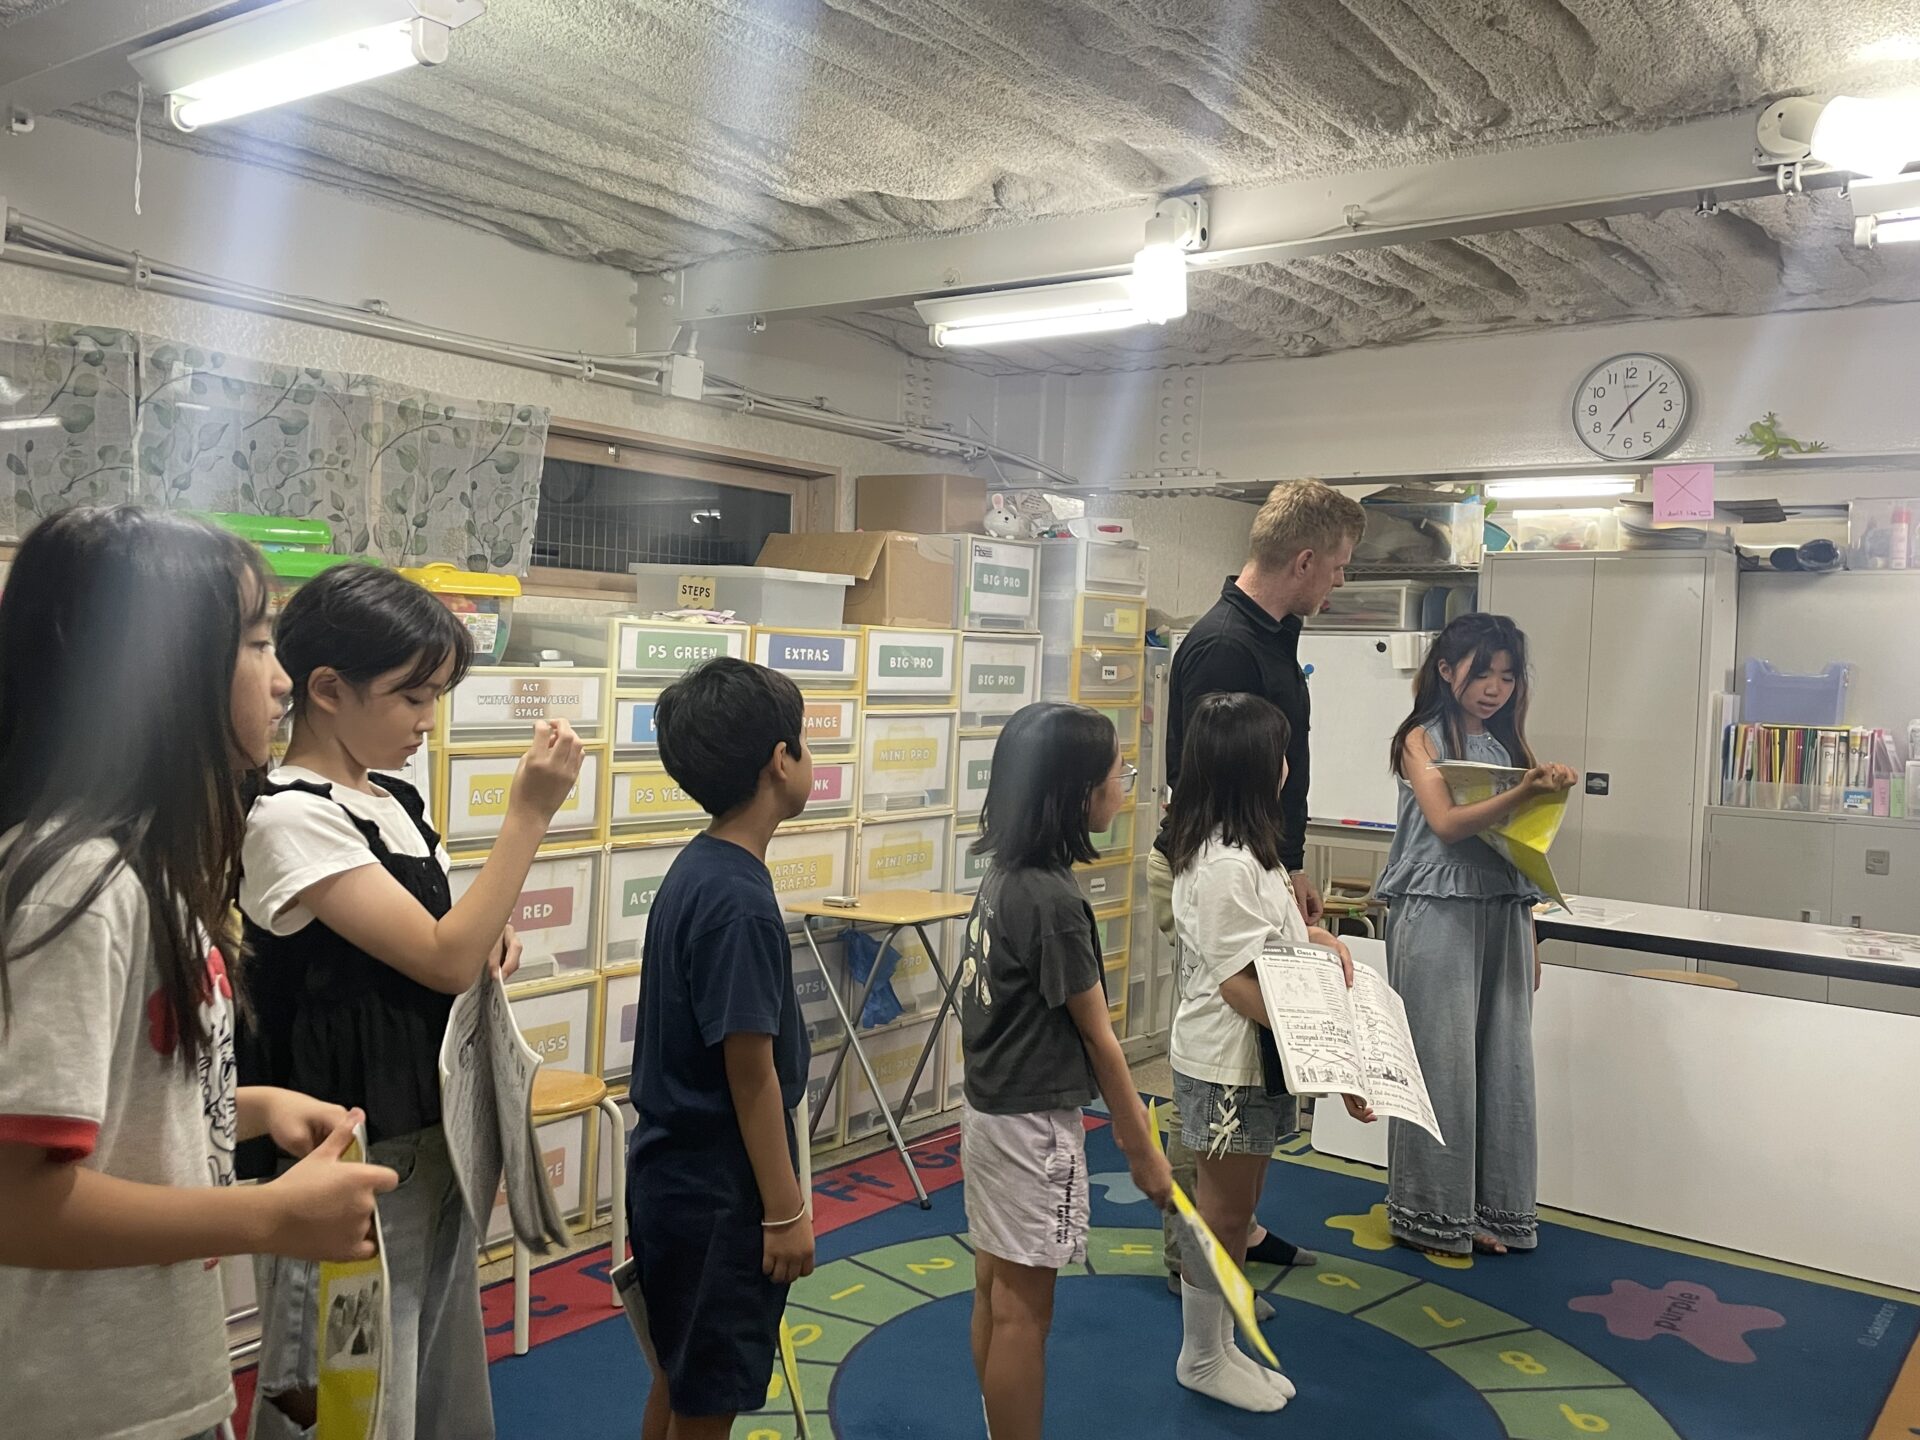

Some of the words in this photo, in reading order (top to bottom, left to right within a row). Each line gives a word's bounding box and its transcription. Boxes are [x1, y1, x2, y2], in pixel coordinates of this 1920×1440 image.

[1608, 373, 1618, 385] 11
[1625, 366, 1638, 379] 12
[1648, 370, 1652, 382] 1
[1593, 386, 1606, 399] 10
[1658, 382, 1668, 394] 2
[1588, 404, 1598, 417] 9
[1663, 399, 1673, 412] 3
[1592, 421, 1602, 434] 8
[1656, 417, 1666, 430] 4
[1606, 433, 1616, 446] 7
[1623, 437, 1633, 449] 6
[1642, 431, 1652, 443] 5
[983, 573, 1000, 586] BIG
[1003, 576, 1021, 588] PRO
[681, 584, 711, 598] STEPS
[648, 644, 668, 659] PS
[673, 646, 718, 660] GREEN
[784, 647, 830, 662] EXTRAS
[889, 655, 909, 668] BIG
[913, 656, 934, 669] PRO
[522, 683, 540, 692] ACT
[977, 674, 995, 686] BIG
[998, 674, 1016, 687] PRO
[477, 694, 579, 705] WHITE/BROWN/BEIGE
[515, 707, 545, 718] STAGE
[802, 715, 839, 729] RANGE
[880, 749, 906, 761] MINI
[910, 747, 930, 760] PRO
[977, 769, 991, 781] BI
[471, 787, 505, 805] ACT
[635, 787, 655, 803] PS
[875, 854, 902, 869] MINI
[905, 851, 927, 865] PRO
[974, 857, 993, 870] BIG
[774, 863, 804, 877] ARTS
[810, 861, 817, 874] &
[773, 874, 817, 892] CRAFTS
[629, 889, 657, 906] ACT
[522, 903, 554, 921] RED
[1056, 1205, 1064, 1223] LADY
[1056, 1225, 1064, 1244] LUCK
[1108, 1243, 1154, 1256] 4
[906, 1257, 956, 1275] 2
[829, 1283, 866, 1301] 1
[1422, 1306, 1466, 1328] 7
[1653, 1292, 1700, 1332] purple
[1499, 1350, 1547, 1375] 8
